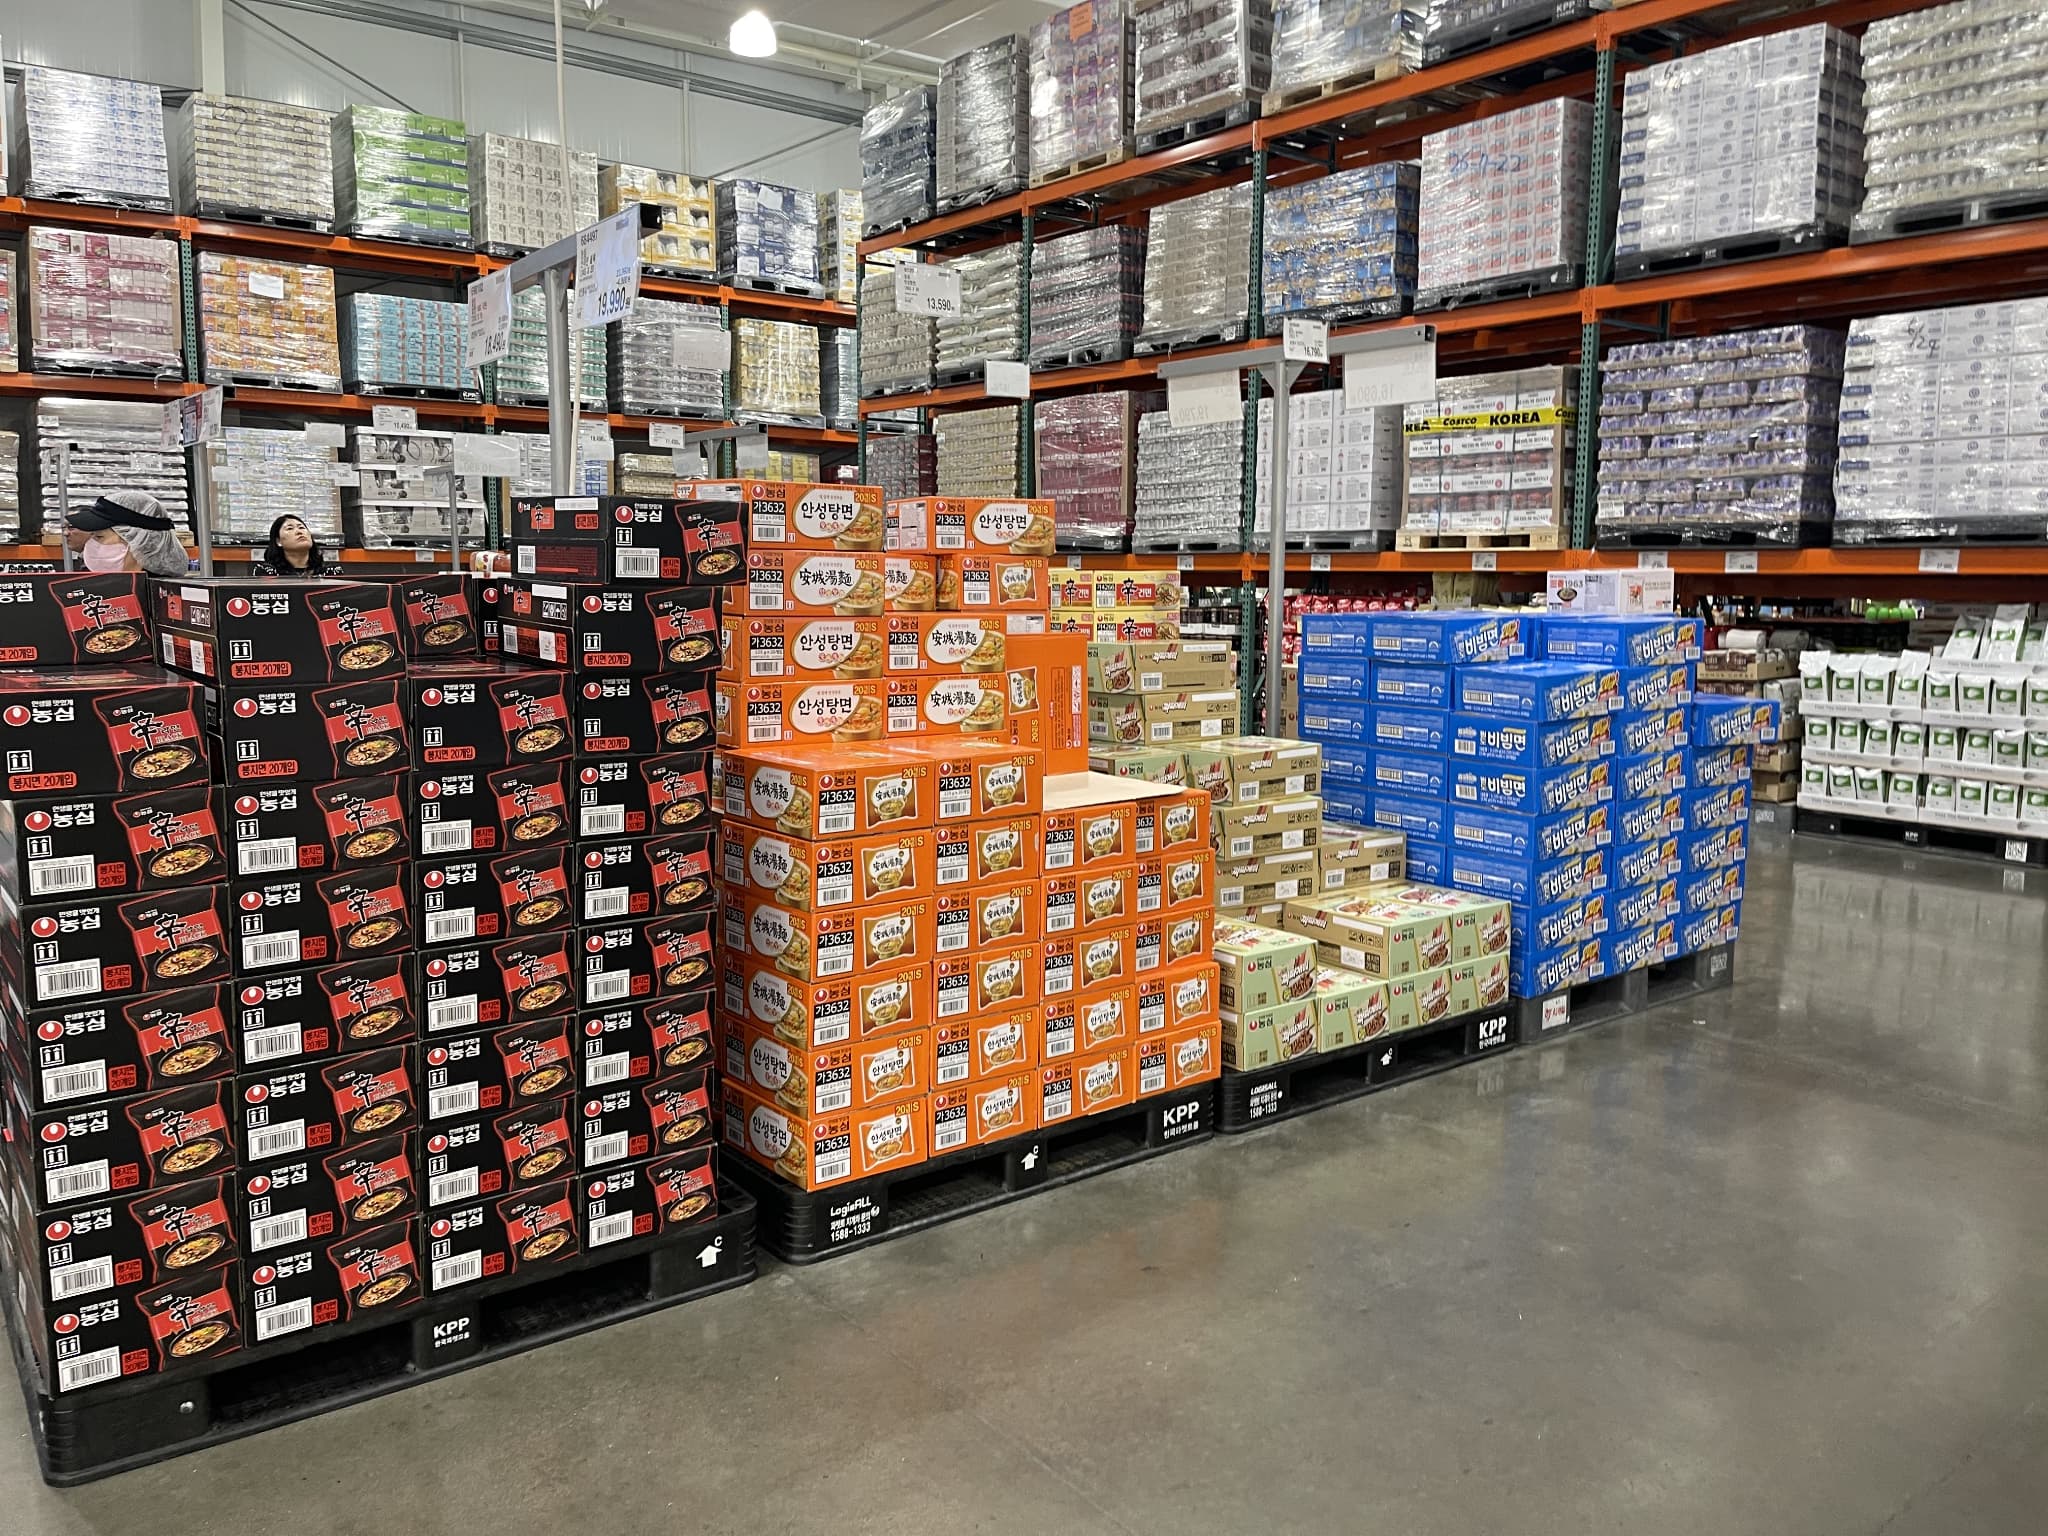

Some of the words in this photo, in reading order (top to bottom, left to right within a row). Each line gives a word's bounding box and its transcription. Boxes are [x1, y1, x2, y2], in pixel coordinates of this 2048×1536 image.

[599, 287, 625, 316] 19,990
[928, 298, 951, 311] 13,590
[1490, 412, 1540, 426] KOREA
[634, 511, 662, 522] 농심
[754, 502, 784, 514] 가3632
[801, 502, 853, 520] 안성탕면
[937, 516, 964, 525] 가3632
[979, 514, 1027, 529] 안성탕면
[751, 570, 782, 582] 가3632
[964, 572, 989, 580] 가3632
[252, 601, 289, 615] 농심
[603, 599, 632, 611] 농심
[752, 637, 783, 648] 가3632
[800, 634, 853, 651] 안성탕면
[890, 633, 917, 643] 가3632
[1464, 630, 1500, 657] 비빔면
[1643, 633, 1675, 657] 비빔면
[444, 691, 476, 704] 농심
[602, 685, 630, 697] 농심
[1561, 682, 1597, 712] 비빔면
[1637, 677, 1668, 704] 비빔면
[258, 700, 296, 715] 농심
[749, 703, 780, 714] 가3632
[798, 698, 851, 715] 안성탕면
[889, 696, 916, 705] 가3632
[31, 707, 74, 723] 농심
[1634, 718, 1665, 746] 비빔면
[1720, 713, 1752, 744] 비빔면
[1488, 733, 1526, 751] 비빔면
[1556, 729, 1589, 757] 비빔면
[599, 768, 627, 781] 농심
[1634, 763, 1663, 790] 비빔면
[1703, 756, 1731, 784] 비빔면
[442, 782, 474, 796] 농심
[1488, 778, 1526, 797] 비빔면
[1555, 775, 1588, 803] 비빔면
[260, 796, 297, 812] 농심
[52, 811, 95, 828] 농심
[1632, 806, 1661, 833] 비빔면
[1553, 819, 1586, 849] 비빔면
[603, 852, 631, 865] 농심
[1630, 848, 1659, 877] 비빔면
[445, 870, 477, 885] 농심
[1551, 865, 1582, 893] 비빔면
[264, 890, 301, 906] 농심
[1628, 891, 1657, 921] 비빔면
[59, 914, 100, 932] 농심
[1550, 909, 1583, 940] 비빔면
[604, 934, 631, 949] 농심
[1624, 933, 1655, 964] 비빔면
[448, 957, 480, 973] 농심
[1549, 953, 1580, 984] 비빔면
[266, 982, 302, 1000] 농심
[65, 1016, 106, 1035] 농심
[604, 1017, 631, 1032] 농심
[1480, 1016, 1507, 1039] KPP
[449, 1044, 481, 1061] 농심
[754, 1048, 787, 1078] 안성탕면
[270, 1079, 306, 1098] 농심
[602, 1097, 629, 1113] 농심
[1164, 1101, 1199, 1128] KPP
[68, 1118, 107, 1136] 농심
[753, 1117, 787, 1147] 안성탕면
[449, 1130, 479, 1147] 농심
[272, 1169, 307, 1188] 농심
[607, 1176, 634, 1193] 농심
[72, 1215, 111, 1234] 농심
[452, 1213, 482, 1231] 농심
[276, 1258, 313, 1278] 농심
[80, 1306, 119, 1326] 농심
[434, 1317, 470, 1339] KPP
